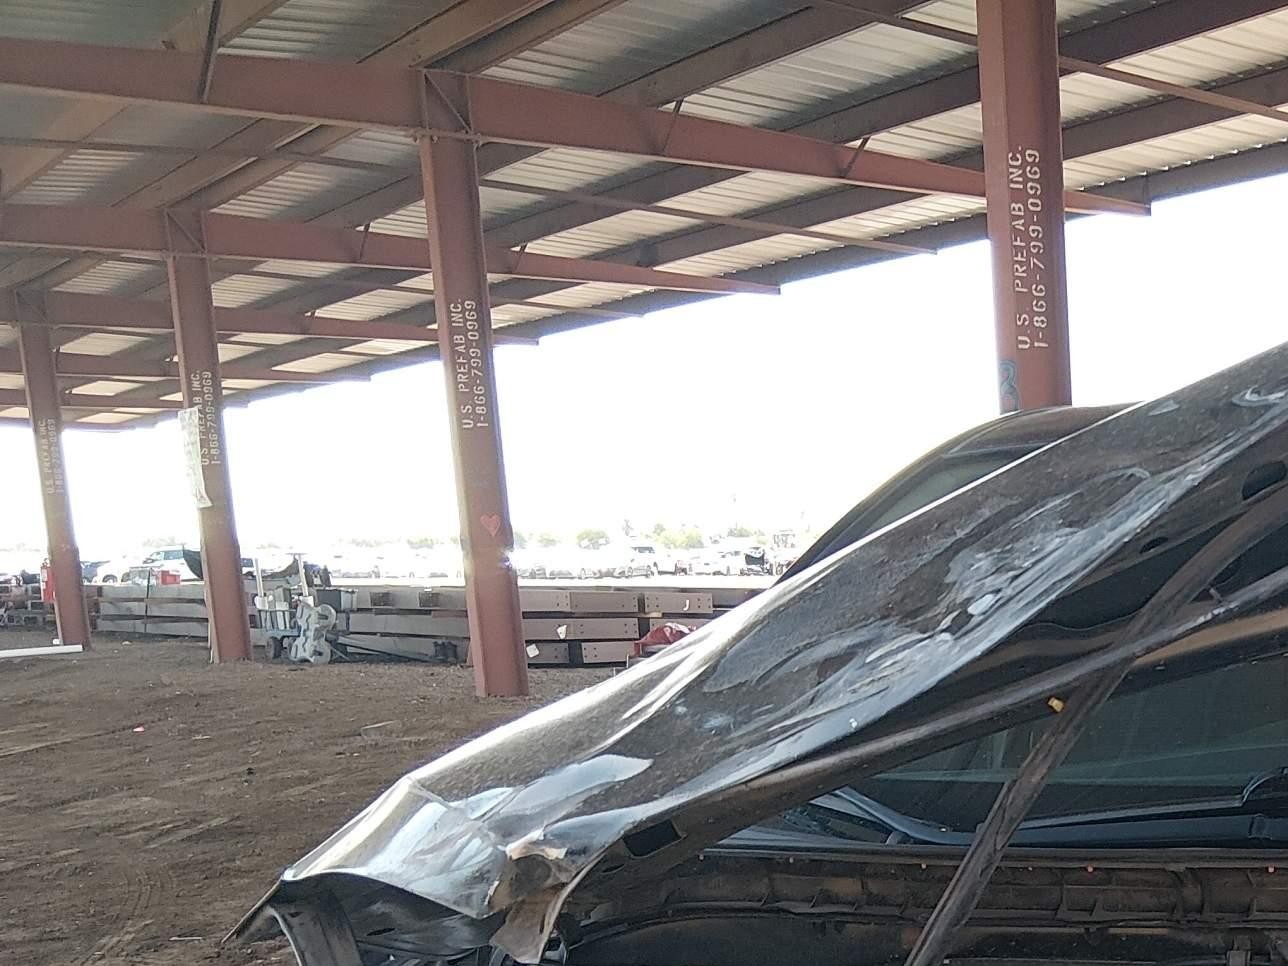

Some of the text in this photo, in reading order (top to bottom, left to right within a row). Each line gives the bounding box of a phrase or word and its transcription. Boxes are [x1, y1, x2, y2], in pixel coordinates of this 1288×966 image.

[1008, 146, 1023, 189] INC.
[1010, 202, 1028, 292] PREFAB
[1025, 149, 1049, 347] 1-866-799-0969
[450, 299, 464, 327] INC.
[453, 335, 470, 392] PREFAB
[464, 300, 489, 427] 1-866-799-0969
